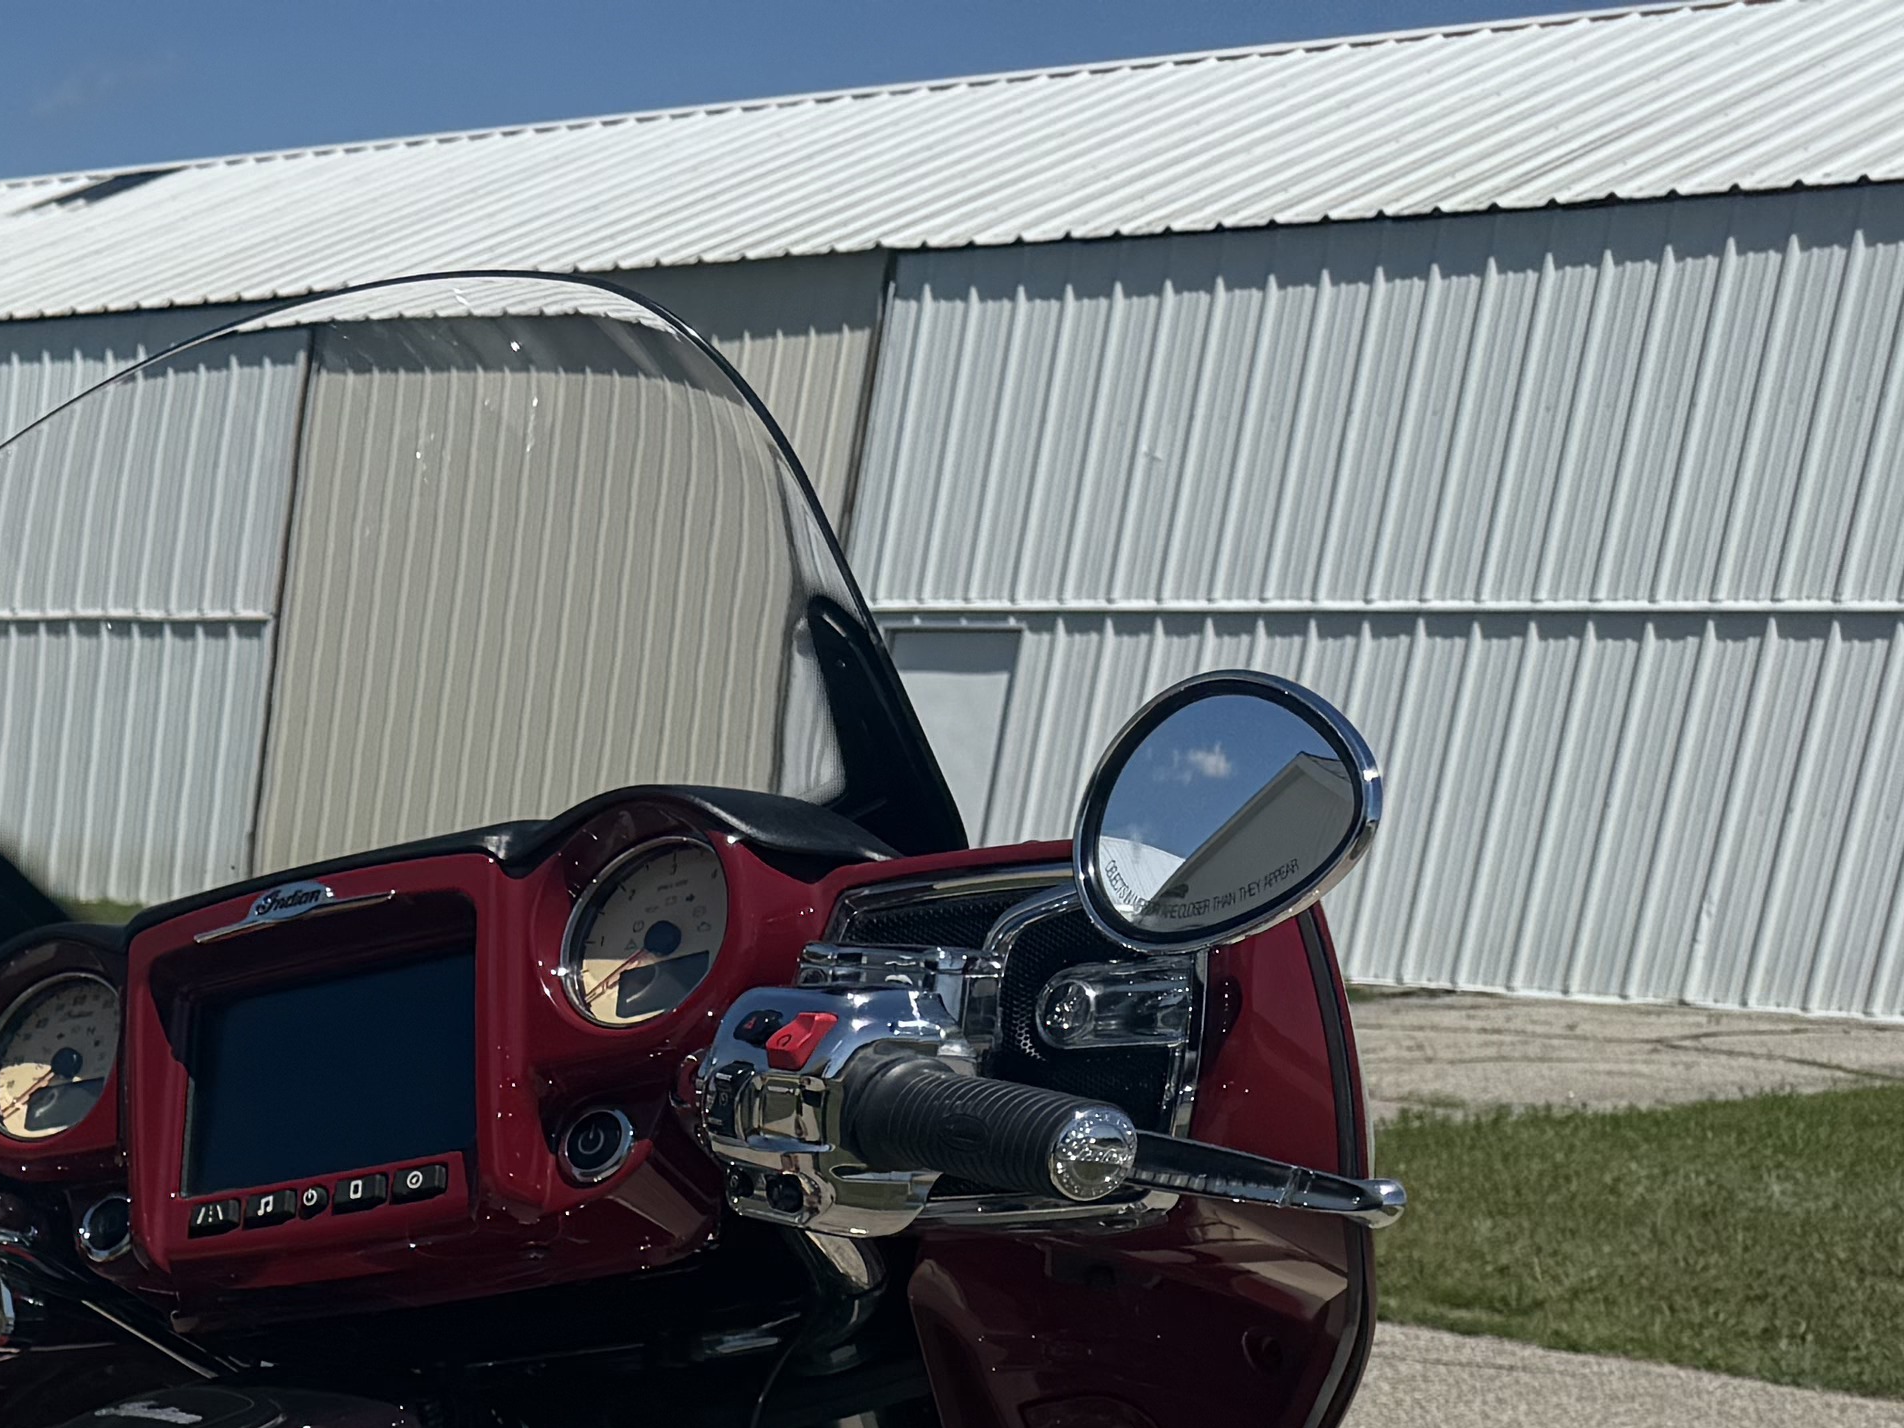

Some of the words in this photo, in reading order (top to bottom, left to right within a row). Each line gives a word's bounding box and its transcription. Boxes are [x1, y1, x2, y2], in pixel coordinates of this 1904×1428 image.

[254, 888, 321, 916] Indian
[1104, 859, 1130, 900] OBJECTS
[1176, 898, 1210, 920] CLOSER
[1211, 891, 1237, 912] THAN
[1239, 878, 1263, 902] THEY
[1263, 857, 1300, 891] APPEAR
